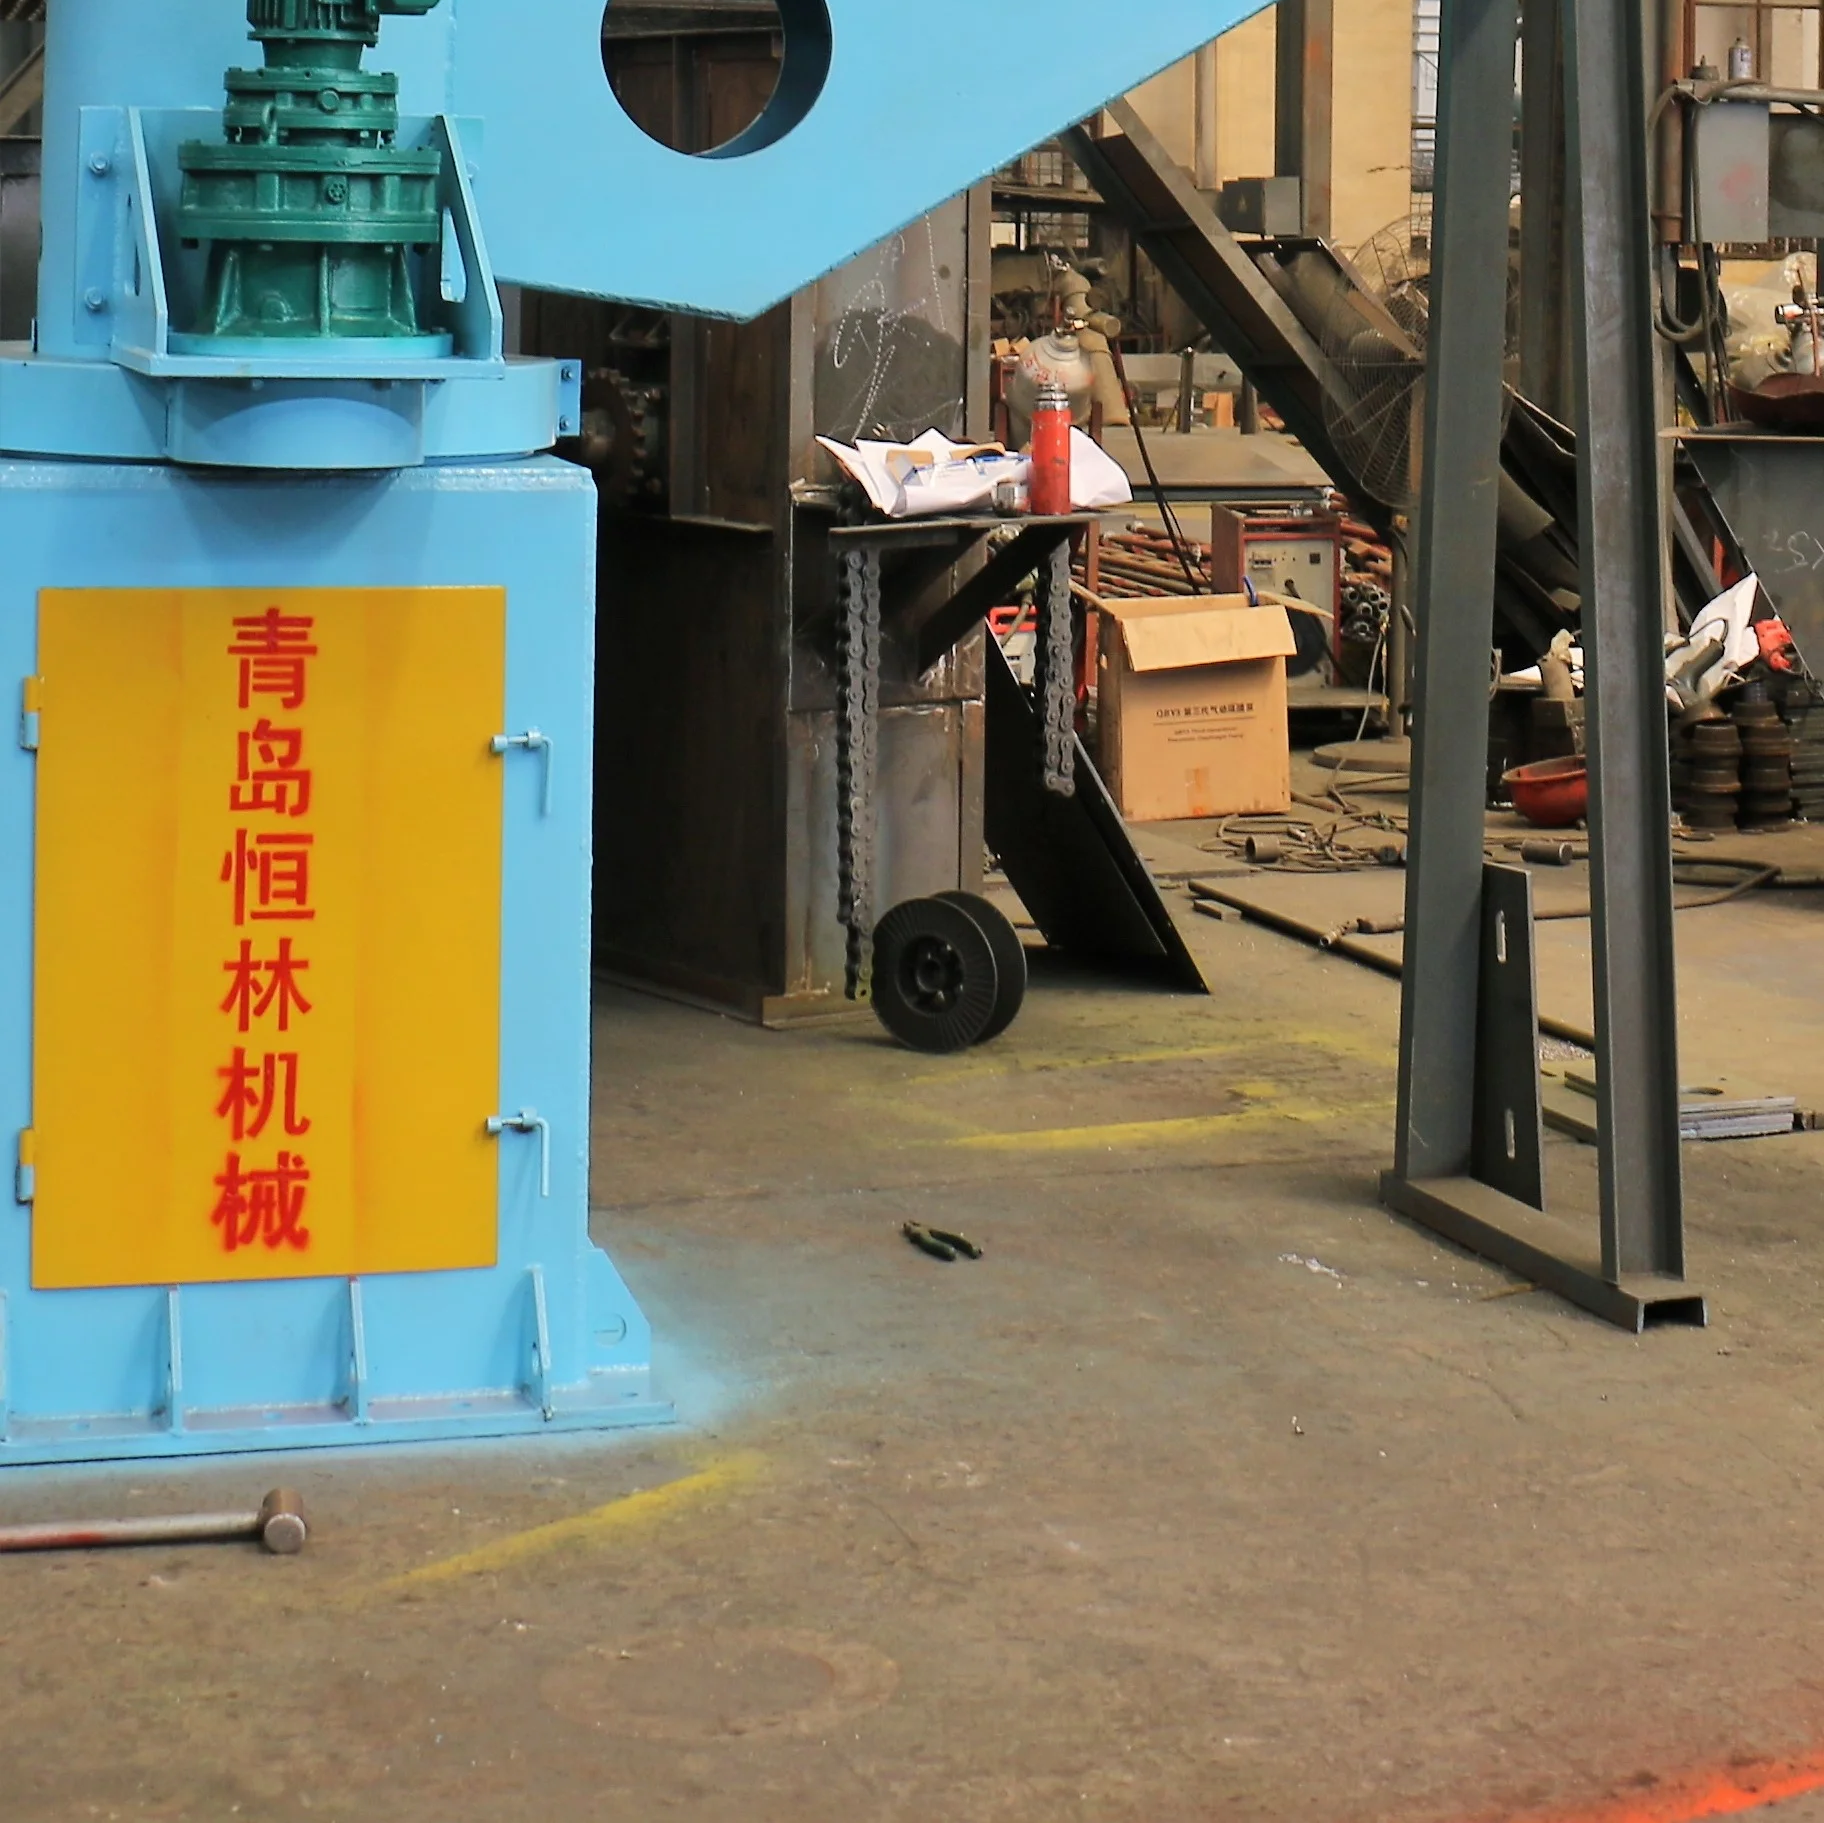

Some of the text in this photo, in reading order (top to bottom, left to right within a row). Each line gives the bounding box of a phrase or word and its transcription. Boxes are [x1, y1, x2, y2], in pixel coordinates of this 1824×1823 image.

[211, 606, 318, 1253] 青岛恒林机械
